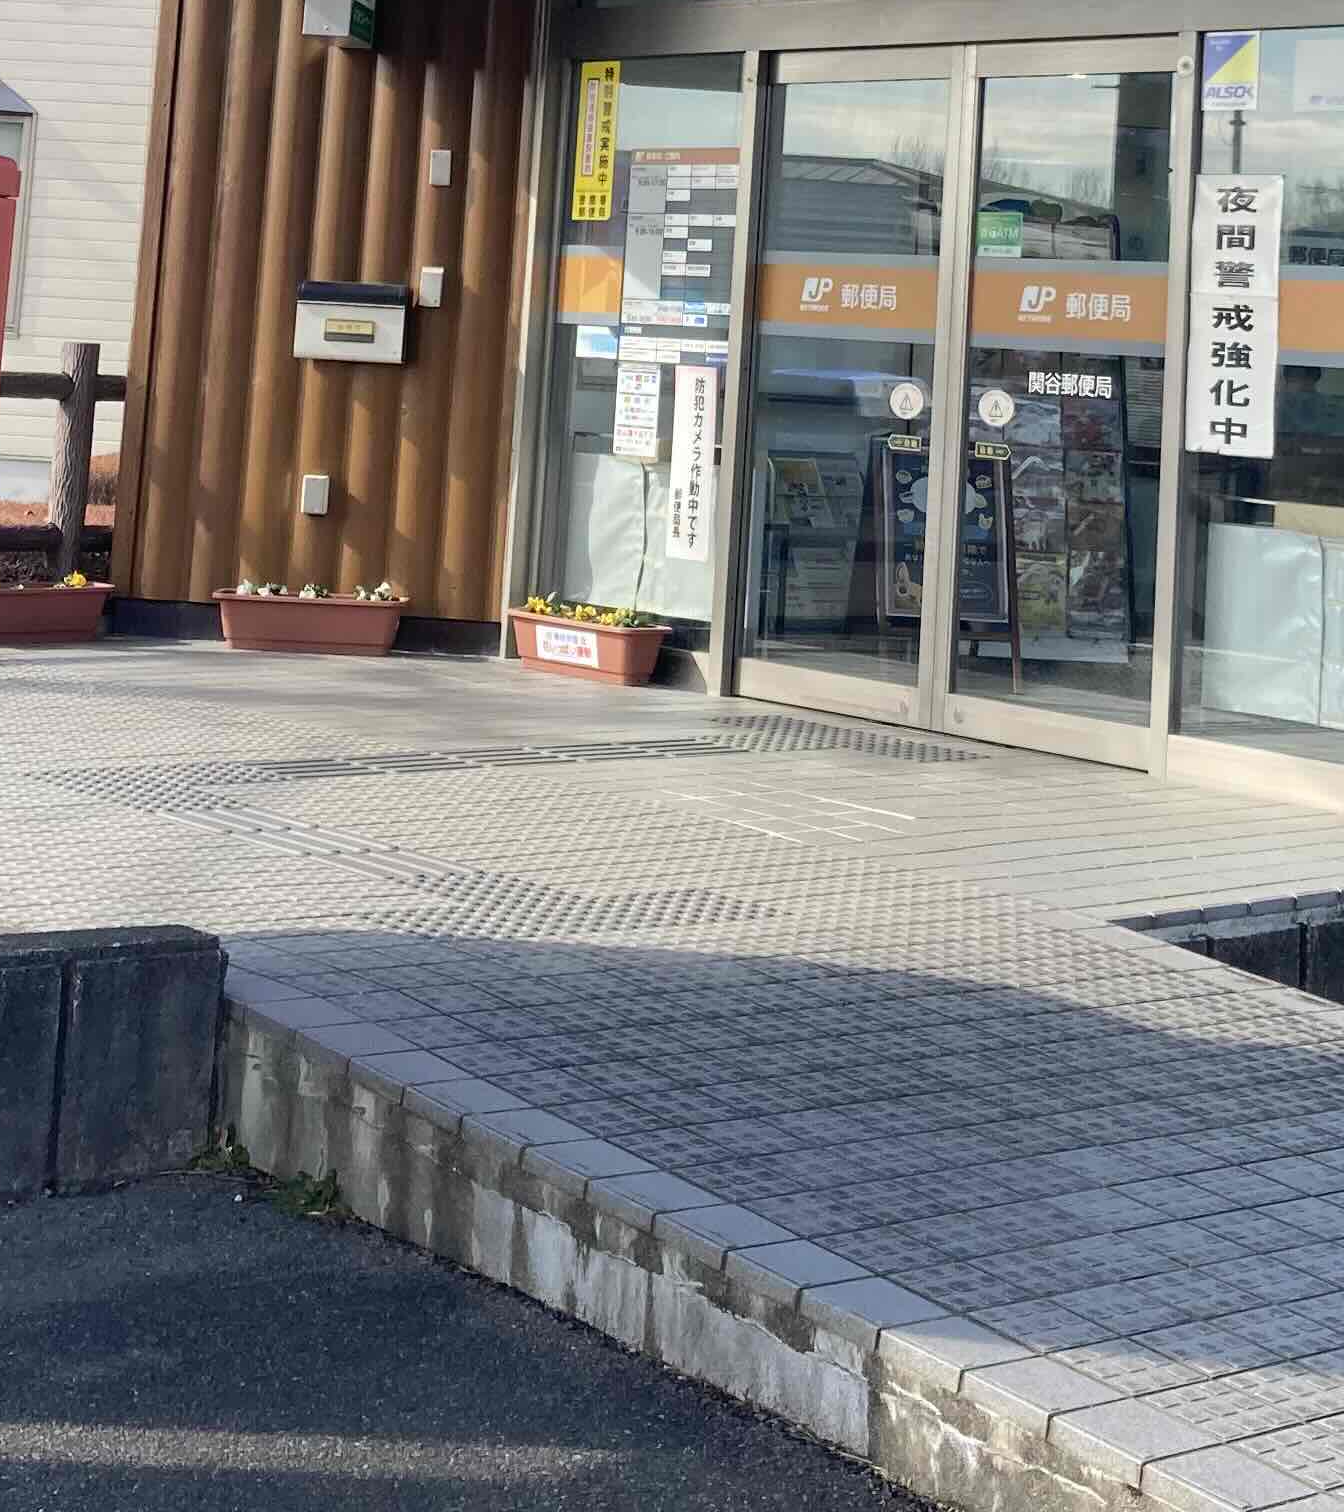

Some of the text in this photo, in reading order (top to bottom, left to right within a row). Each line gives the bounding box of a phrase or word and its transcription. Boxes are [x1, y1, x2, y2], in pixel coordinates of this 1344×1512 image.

[840, 283, 897, 311] 郵便局
[1065, 292, 1132, 323] 郵便局
[1209, 186, 1259, 445] 夜間警戒強化中
[1027, 371, 1113, 400] 関谷郵便局
[687, 376, 706, 549] 防犯カメラ作動中です
